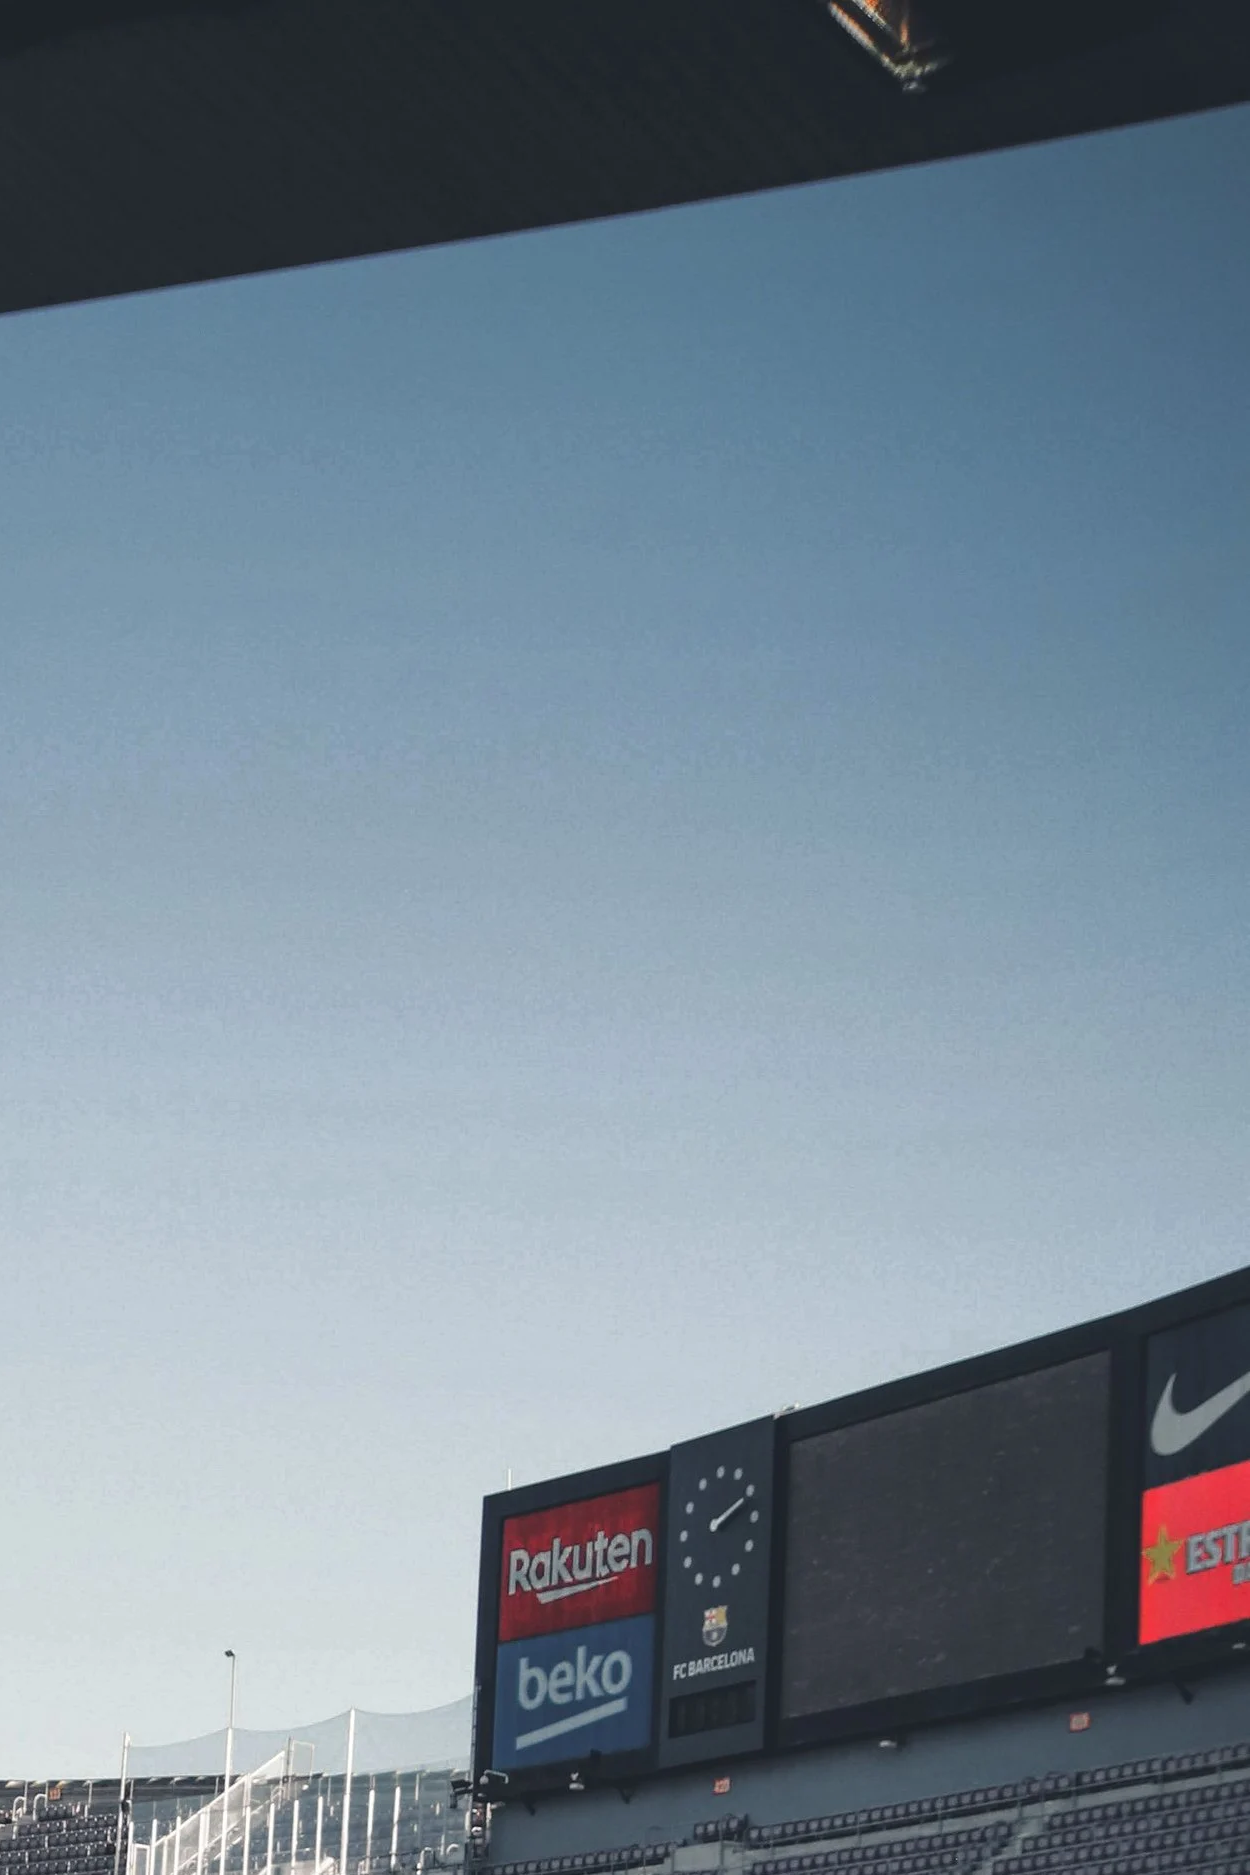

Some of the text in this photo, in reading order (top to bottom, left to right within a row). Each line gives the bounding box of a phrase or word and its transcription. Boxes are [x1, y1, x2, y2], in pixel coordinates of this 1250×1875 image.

[508, 1528, 653, 1595] Rakuten
[518, 1646, 632, 1710] beko
[673, 1647, 755, 1680] FC BARCELONA
